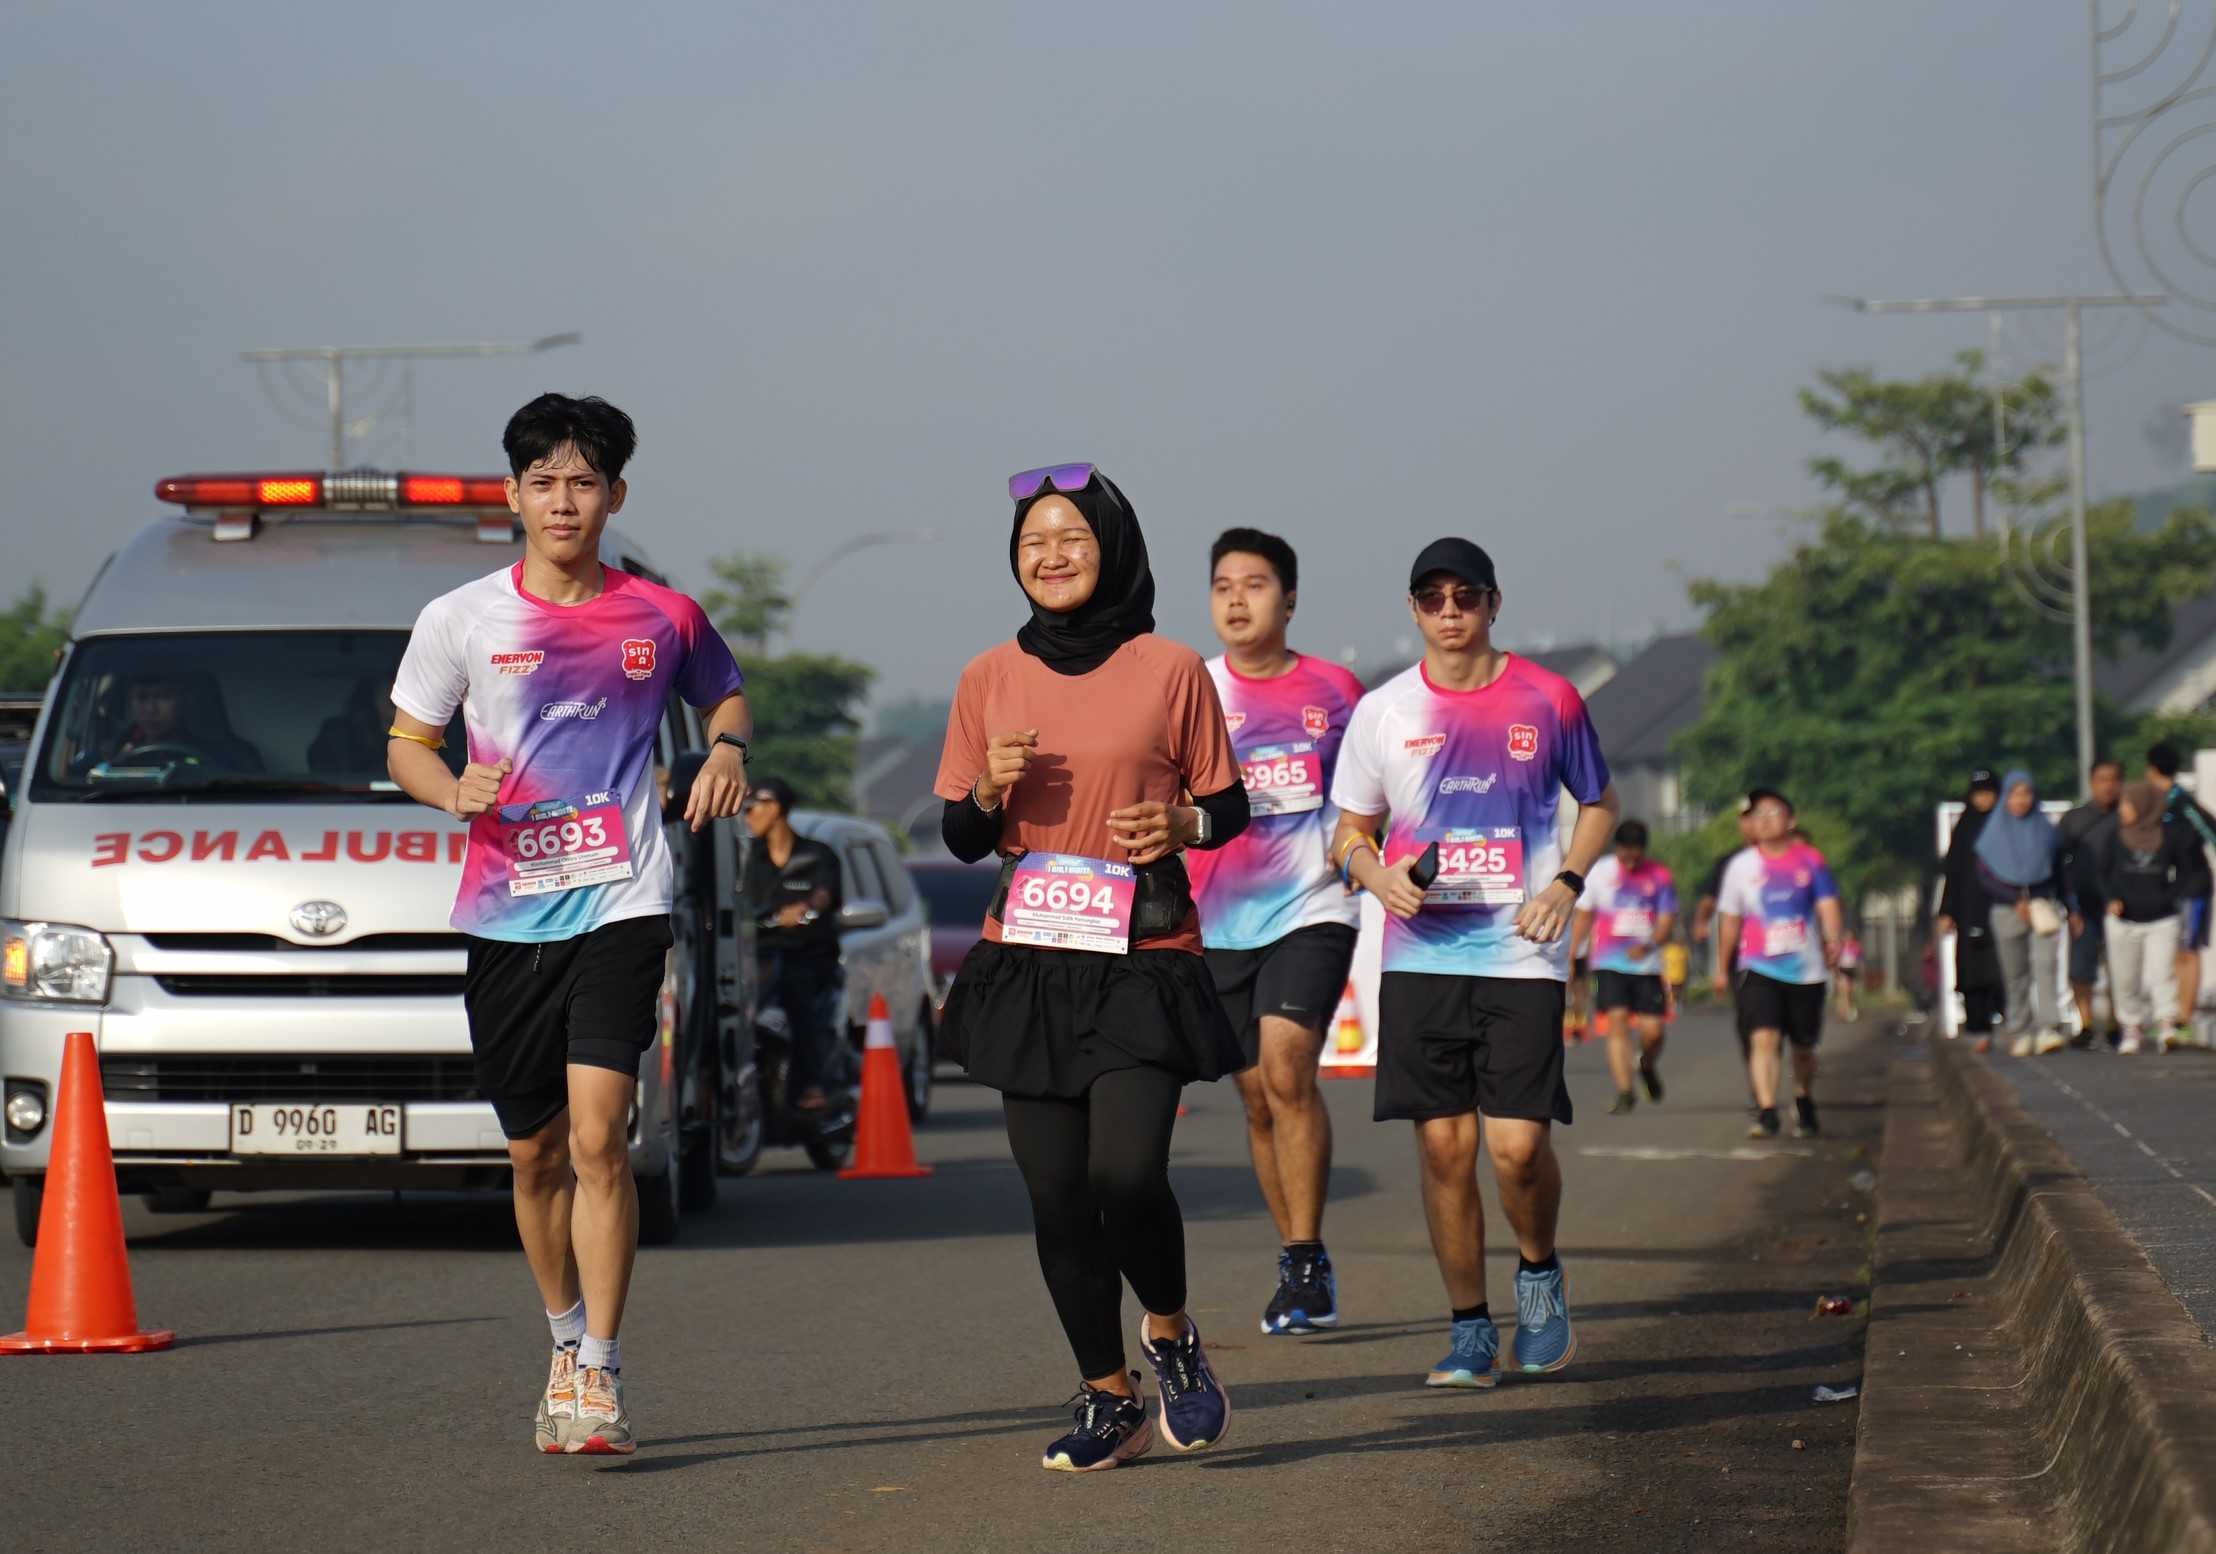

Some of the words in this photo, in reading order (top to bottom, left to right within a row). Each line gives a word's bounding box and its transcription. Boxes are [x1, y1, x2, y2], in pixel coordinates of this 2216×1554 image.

[490, 651, 543, 665] ENERVON
[499, 665, 531, 674] FIZZ
[584, 791, 610, 805] 10K
[518, 816, 607, 858] 6693
[1494, 827, 1515, 839] 10K
[1104, 863, 1130, 877] 10K
[1023, 877, 1115, 914] 6694
[239, 1108, 253, 1135] D
[273, 1108, 336, 1136] 9960
[365, 1108, 396, 1136] AG
